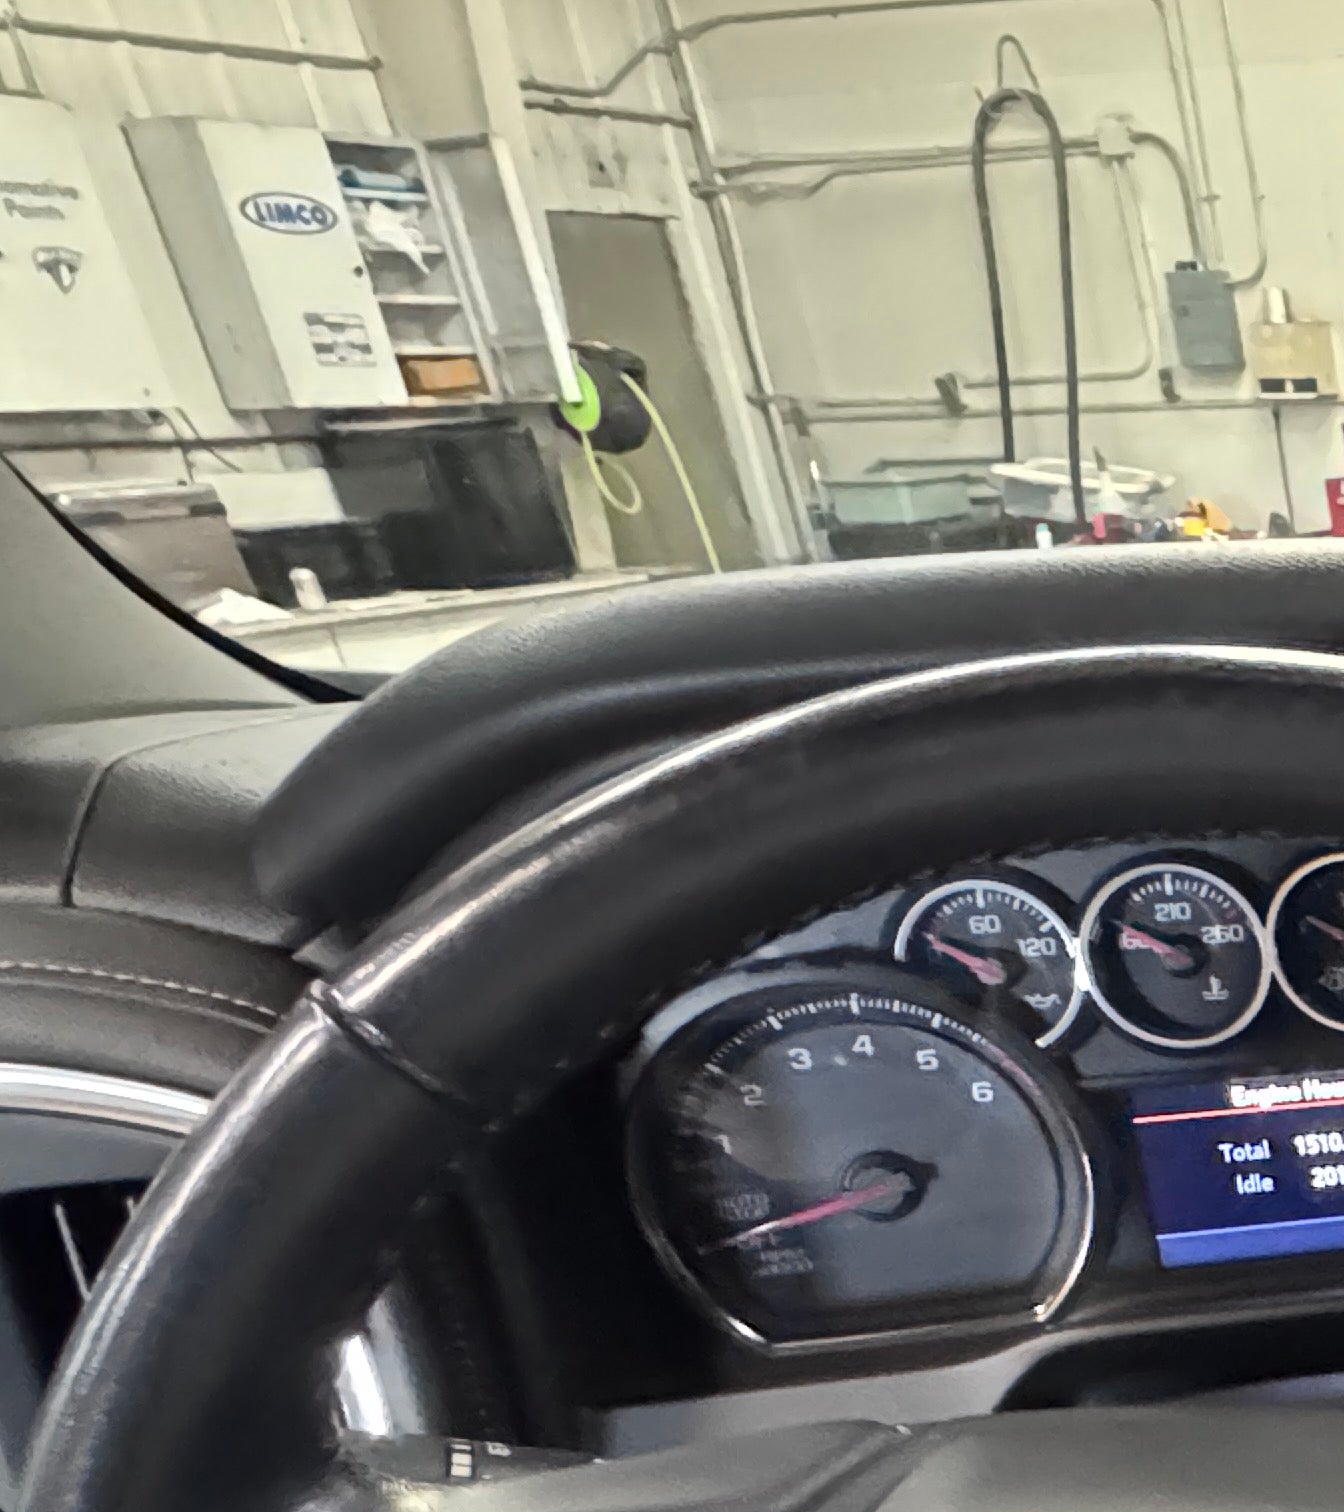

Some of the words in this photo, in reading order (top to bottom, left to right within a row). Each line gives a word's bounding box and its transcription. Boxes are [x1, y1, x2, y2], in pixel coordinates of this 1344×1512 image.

[253, 200, 329, 226] LIMCO
[1154, 901, 1192, 922] 210
[969, 914, 1001, 936] 60
[1200, 923, 1244, 944] 260
[1018, 937, 1058, 958] 120
[851, 1033, 876, 1057] 4
[787, 1047, 813, 1071] 3
[915, 1047, 940, 1072] 5
[741, 1084, 765, 1107] 2
[970, 1080, 995, 1103] 6
[1217, 1138, 1272, 1164] Total
[1235, 1172, 1275, 1195] Idle
